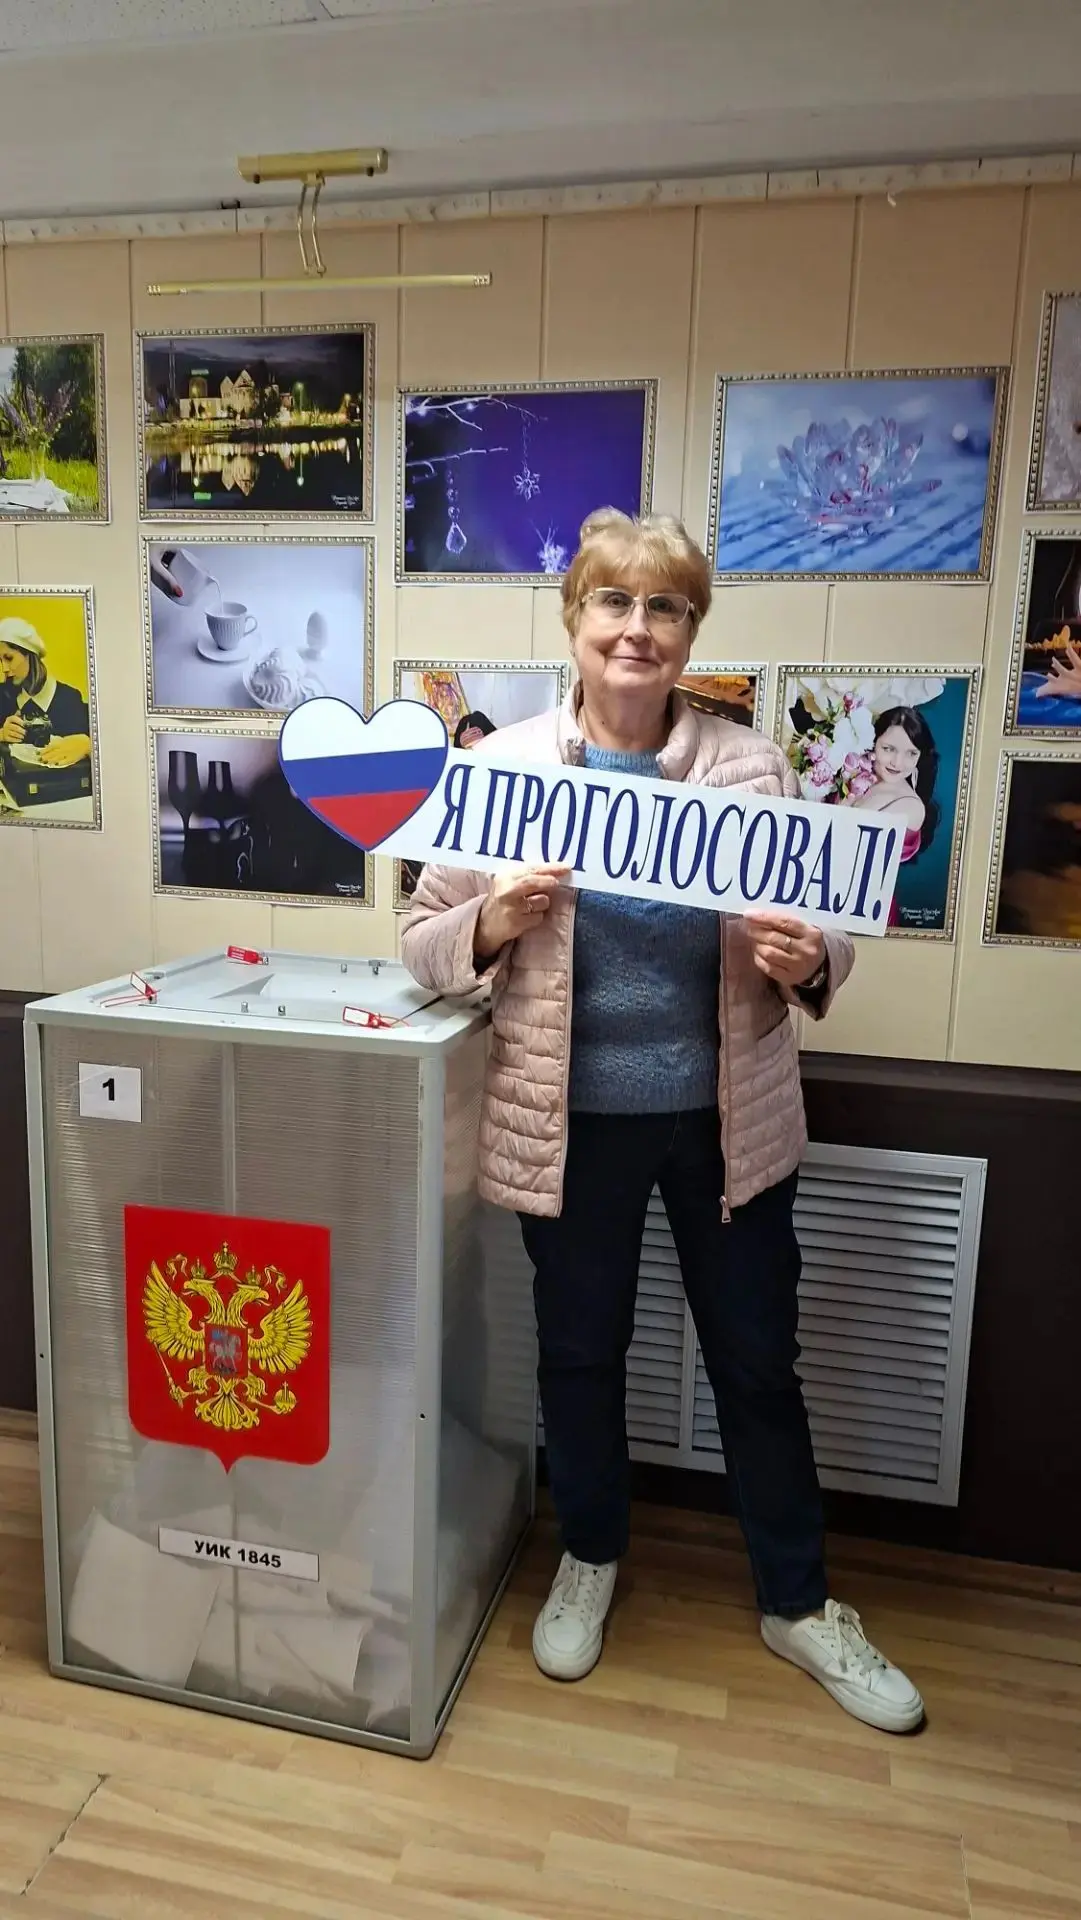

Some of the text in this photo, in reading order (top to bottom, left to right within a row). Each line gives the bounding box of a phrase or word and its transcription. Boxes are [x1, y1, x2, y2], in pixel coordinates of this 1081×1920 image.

[432, 763, 897, 921] Я ПРОГОЛОСОВАЛ!
[102, 1077, 115, 1102] 1
[194, 1540, 282, 1568] УИК 1845
